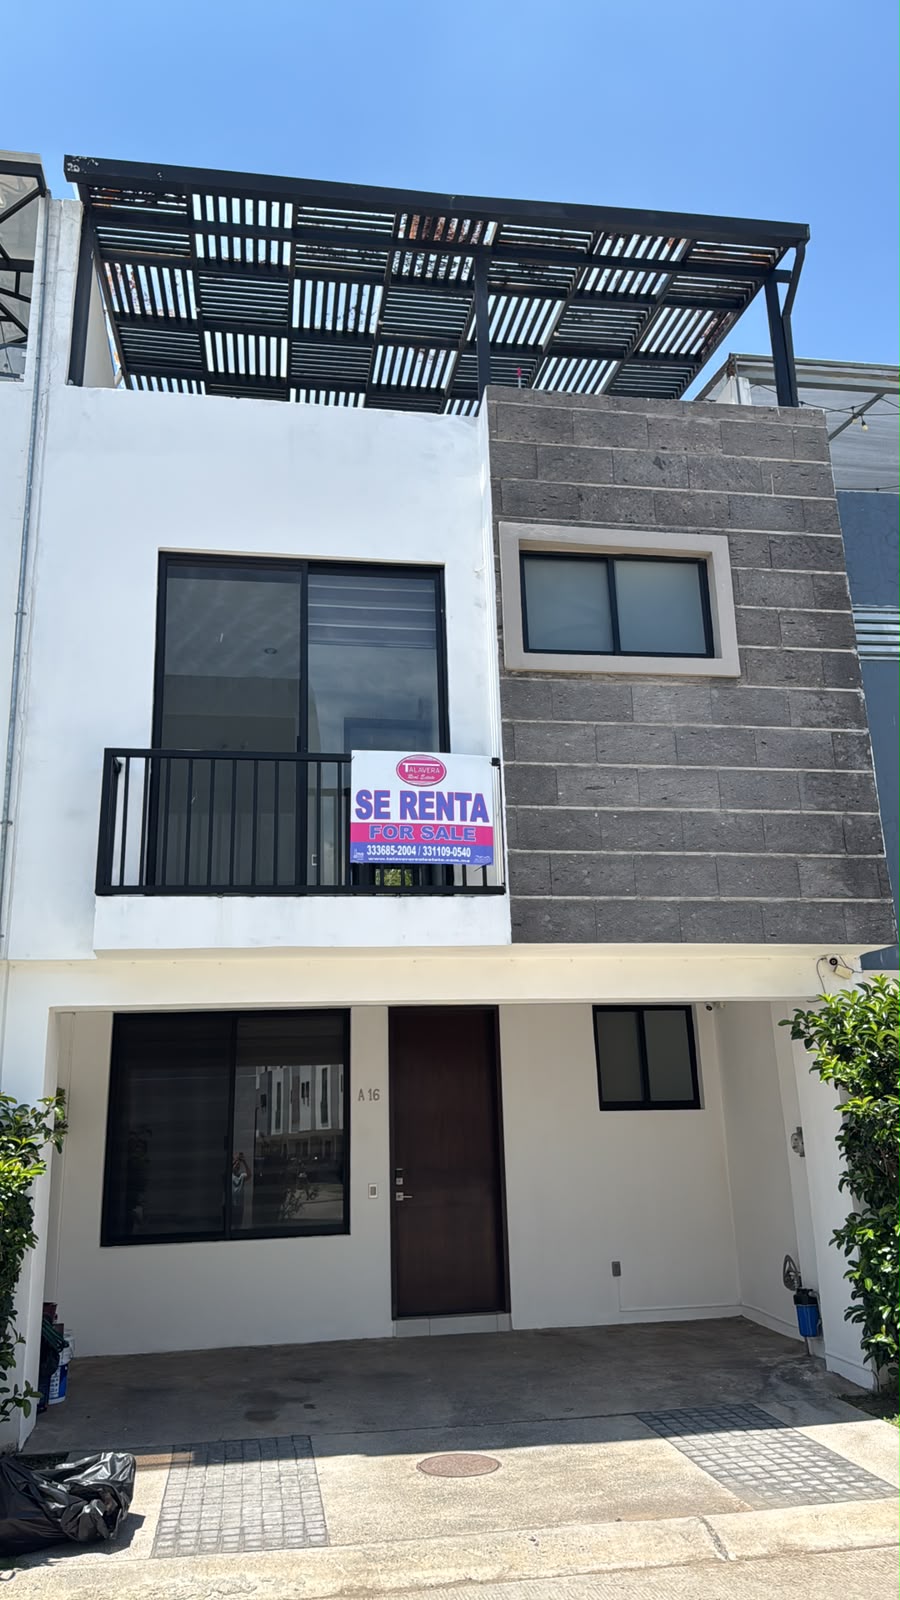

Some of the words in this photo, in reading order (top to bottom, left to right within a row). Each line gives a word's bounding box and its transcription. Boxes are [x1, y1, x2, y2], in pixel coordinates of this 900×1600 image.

[402, 763, 440, 774] TALAVERA
[355, 789, 391, 820] SE
[399, 790, 490, 823] RENTA
[369, 825, 415, 840] FOR
[420, 826, 476, 841] SALE
[366, 844, 416, 856] 333685-2004
[422, 845, 471, 858] 331109-0540
[358, 1088, 365, 1101] A
[368, 1088, 380, 1101] 16
